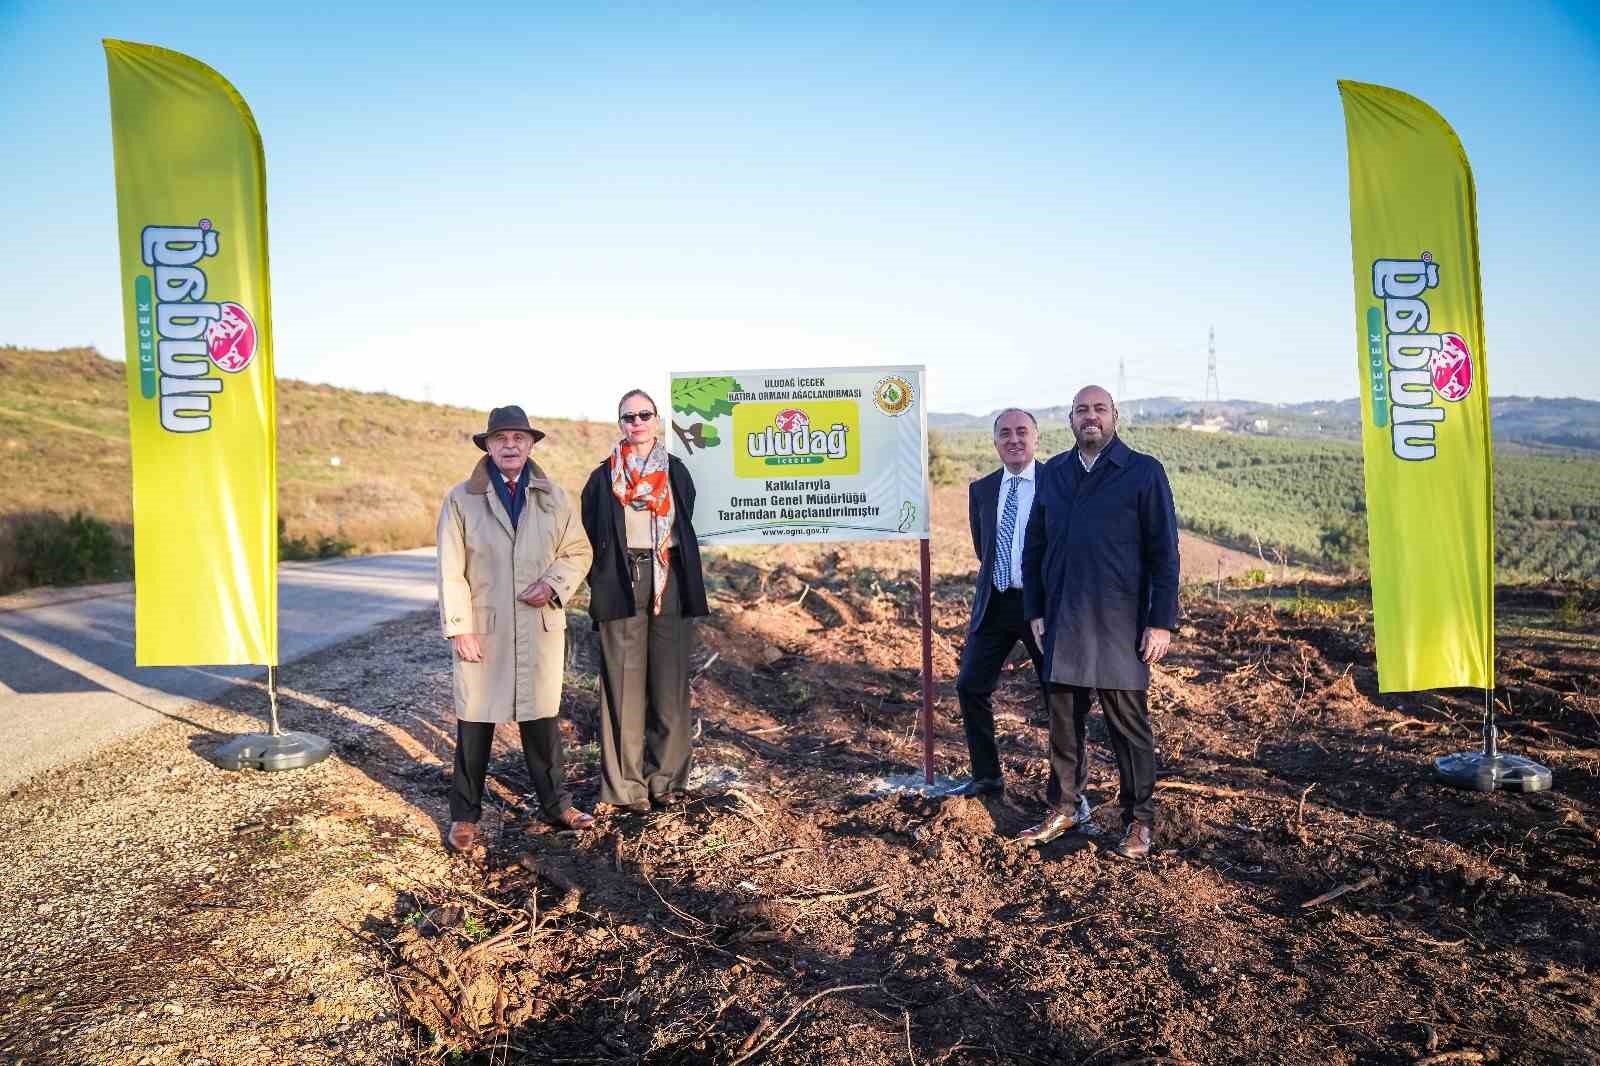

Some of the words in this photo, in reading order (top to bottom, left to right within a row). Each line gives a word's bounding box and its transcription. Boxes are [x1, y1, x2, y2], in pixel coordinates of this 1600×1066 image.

[764, 378, 795, 389] ULUDAĞ
[758, 391, 791, 401] ORMANI
[748, 424, 848, 459] uludağ
[765, 479, 831, 492] Katkılarıyla
[730, 496, 767, 507] Orman
[771, 495, 803, 506] Genel
[806, 493, 867, 505] Müdürlüğü
[718, 509, 777, 521] Tarafından
[780, 506, 880, 520] Ağaçlandırılmıştır
